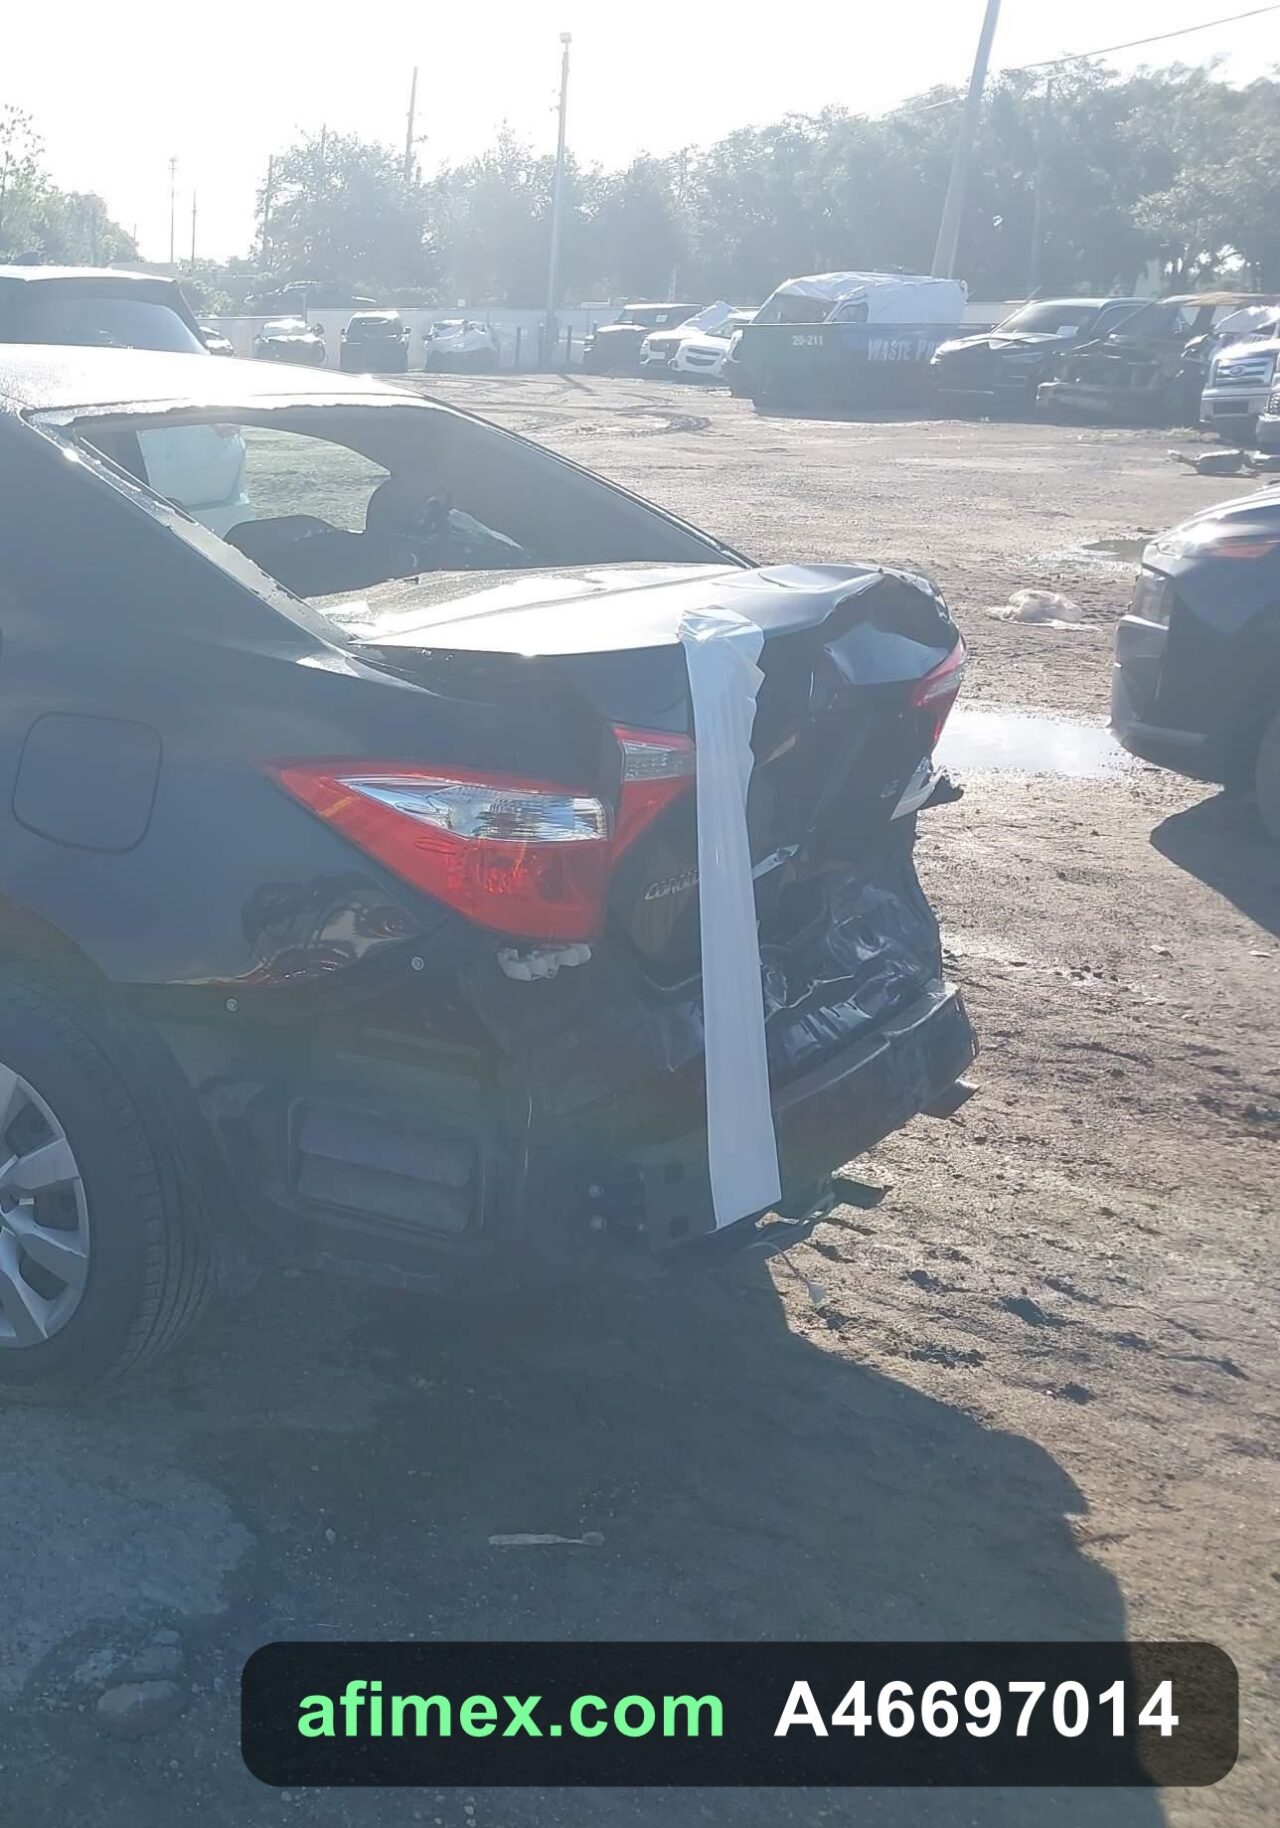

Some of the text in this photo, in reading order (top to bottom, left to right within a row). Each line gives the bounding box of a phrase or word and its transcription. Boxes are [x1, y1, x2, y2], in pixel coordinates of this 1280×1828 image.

[792, 335, 823, 347] 20-211
[867, 338, 938, 361] WASTE PR
